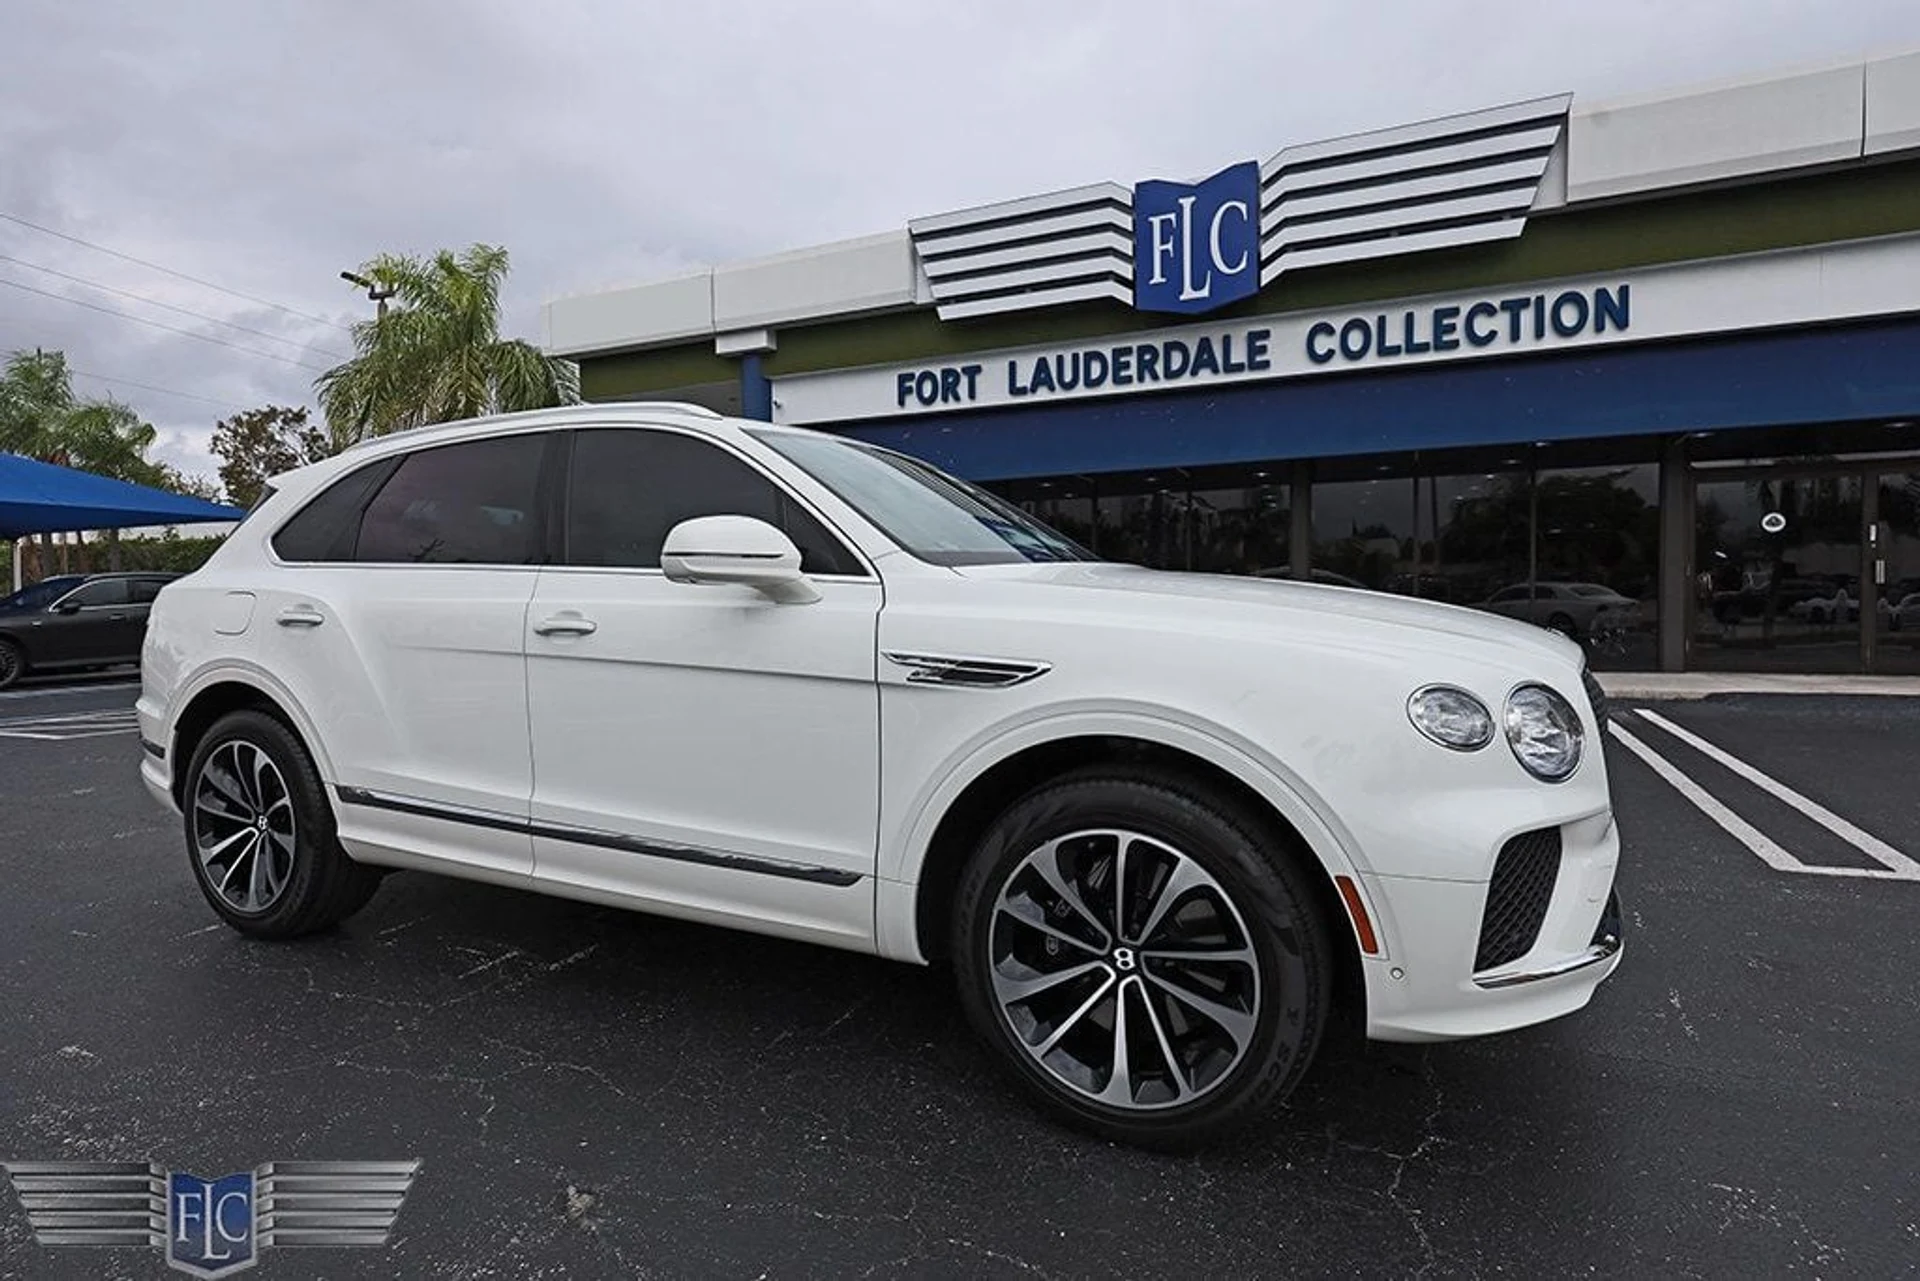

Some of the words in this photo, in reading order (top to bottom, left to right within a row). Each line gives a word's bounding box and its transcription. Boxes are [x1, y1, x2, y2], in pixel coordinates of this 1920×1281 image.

[1148, 196, 1249, 301] FLC
[897, 364, 982, 407] FORT
[1008, 329, 1271, 396] LAUDERDALE
[1305, 285, 1630, 364] COLLECTION
